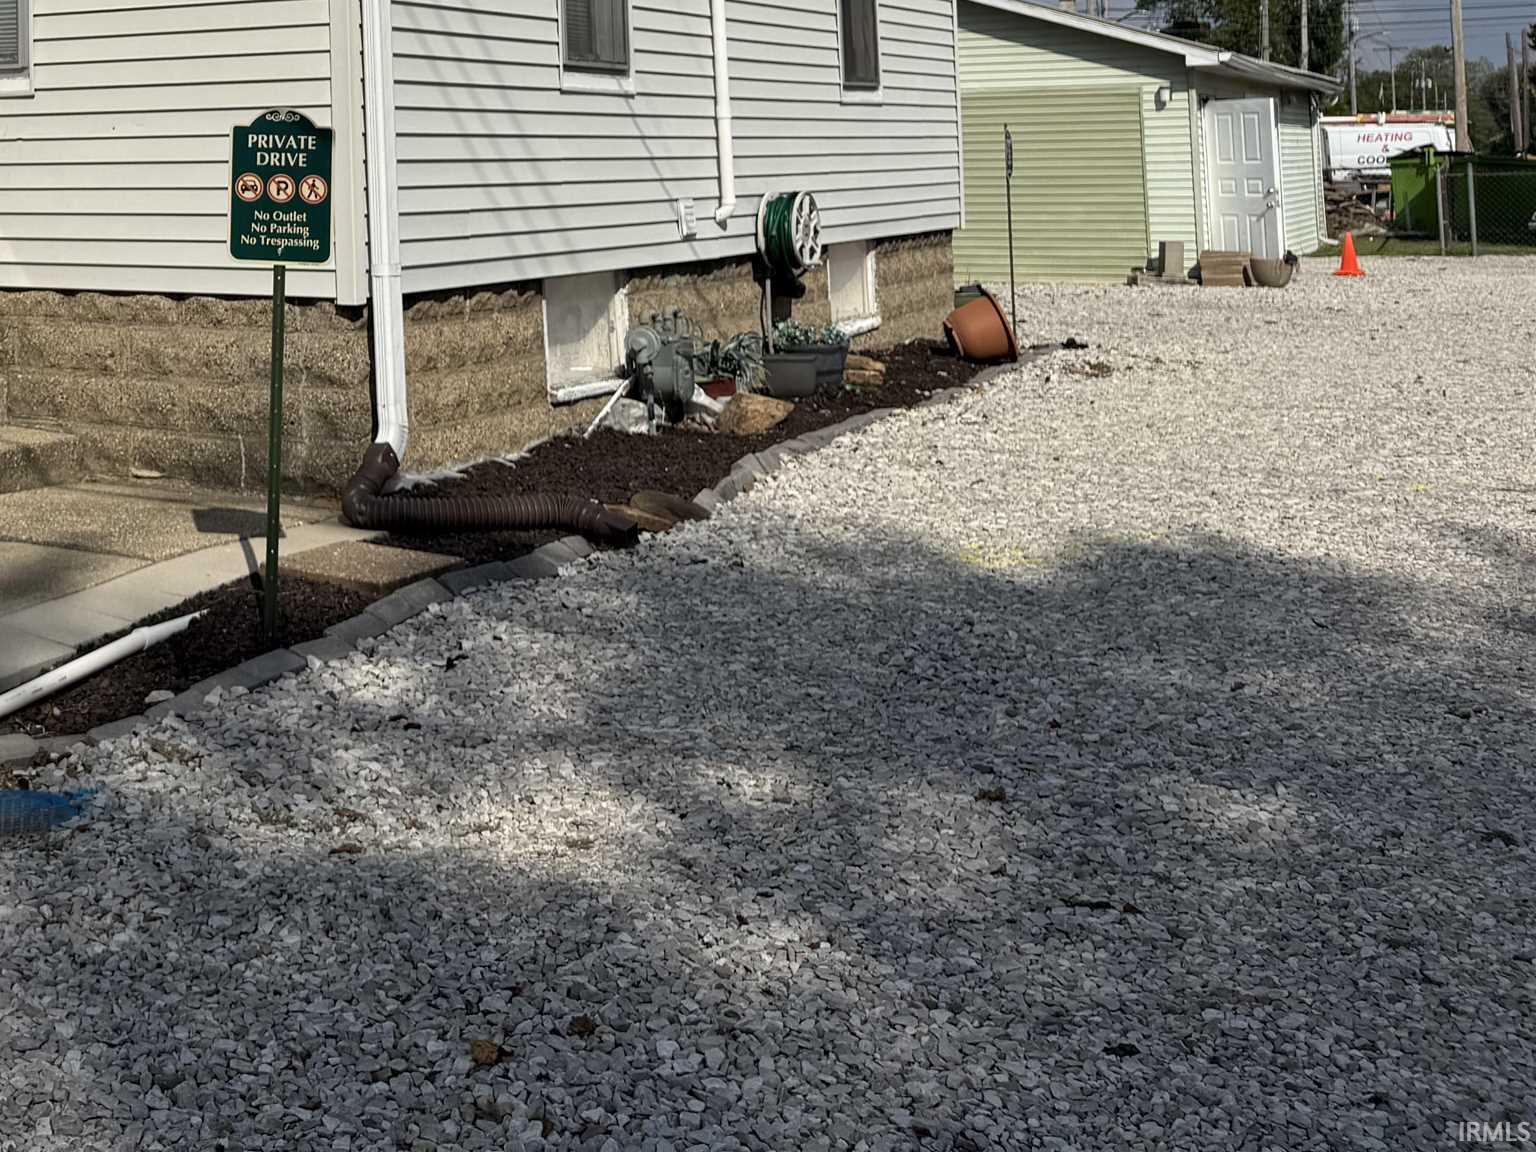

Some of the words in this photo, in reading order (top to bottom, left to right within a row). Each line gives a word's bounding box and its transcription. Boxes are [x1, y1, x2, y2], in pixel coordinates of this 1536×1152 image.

[248, 134, 316, 150] PRIVATE
[1357, 131, 1413, 143] HEATING
[1381, 144, 1390, 153] &
[256, 151, 307, 167] DRIVE
[254, 210, 270, 221] No
[272, 210, 307, 222] Outlet
[251, 222, 267, 233] No
[270, 223, 310, 238] Parking
[240, 234, 257, 245] No
[259, 234, 320, 251] Trespassing
